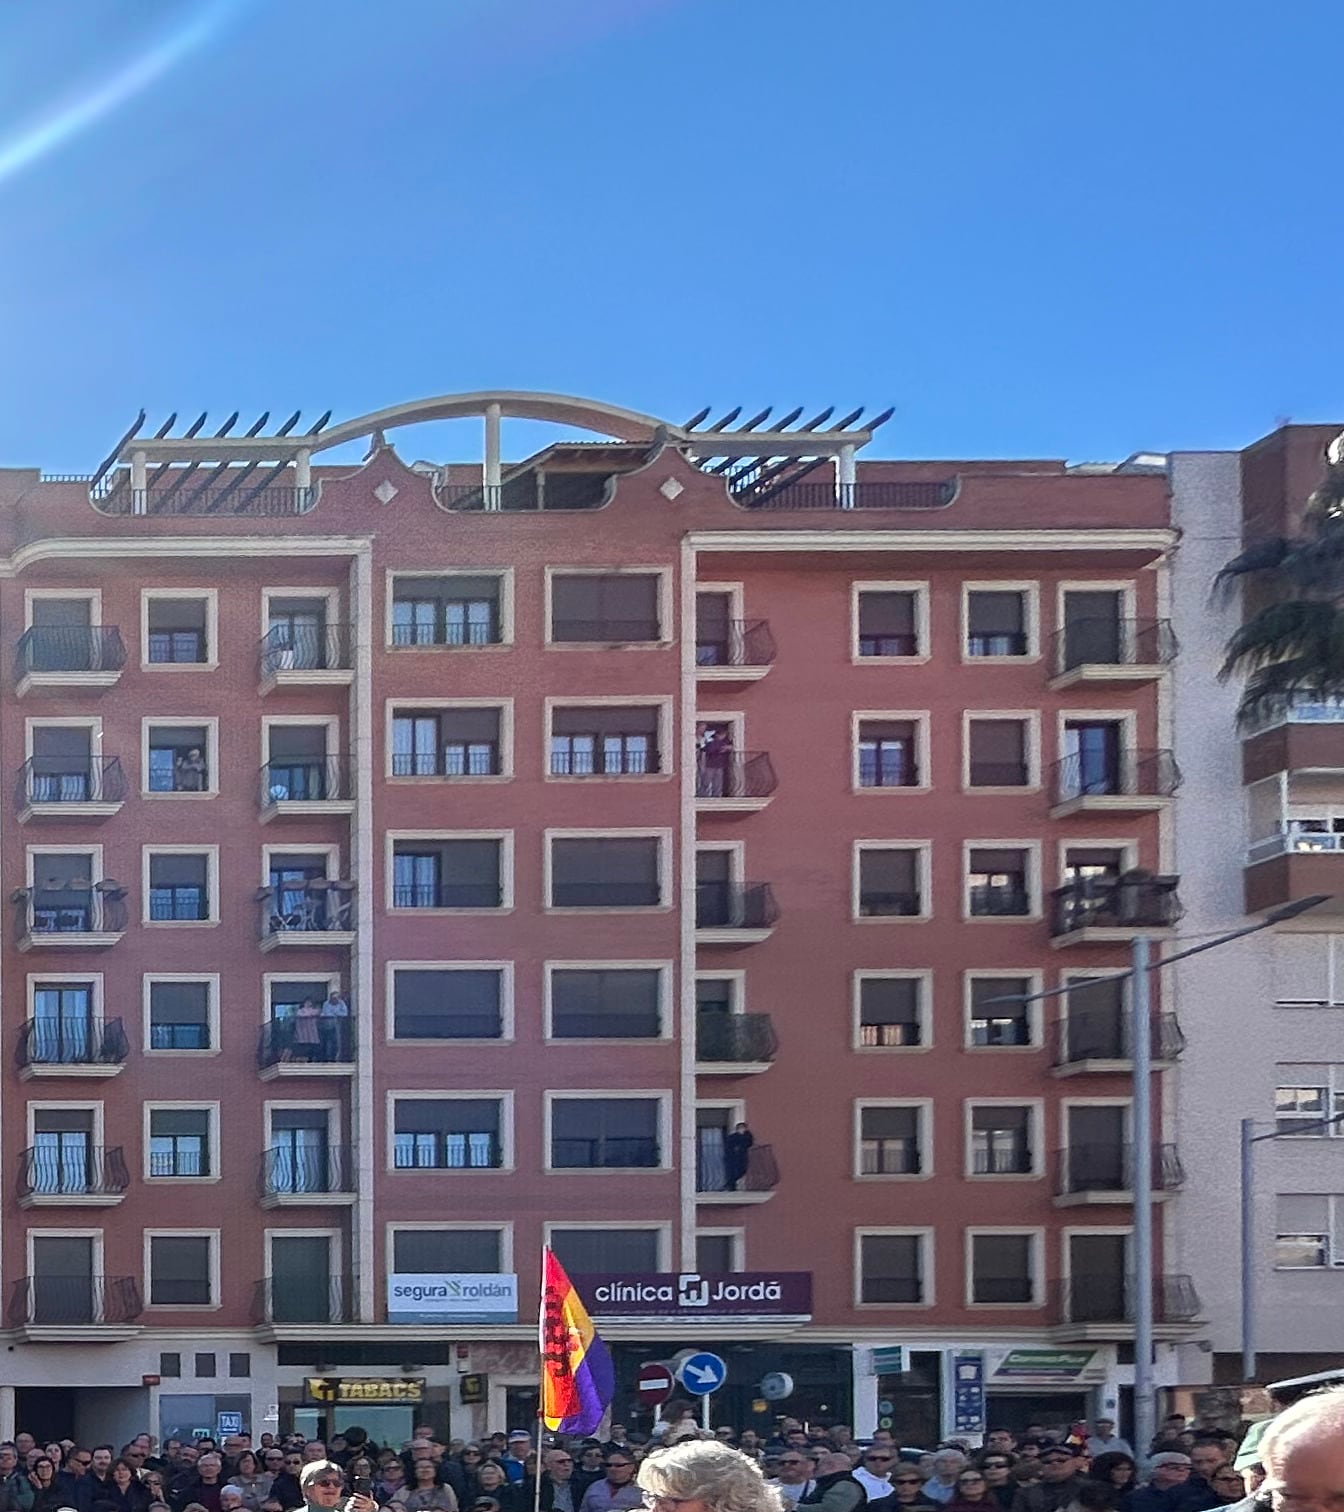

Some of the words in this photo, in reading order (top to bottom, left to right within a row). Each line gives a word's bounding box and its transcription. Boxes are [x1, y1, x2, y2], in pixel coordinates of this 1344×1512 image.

[394, 1286, 447, 1301] segura
[462, 1282, 512, 1297] roldán
[595, 1281, 673, 1301] clínica
[338, 1383, 422, 1398] TABACS
[221, 1415, 239, 1427] TAXI
